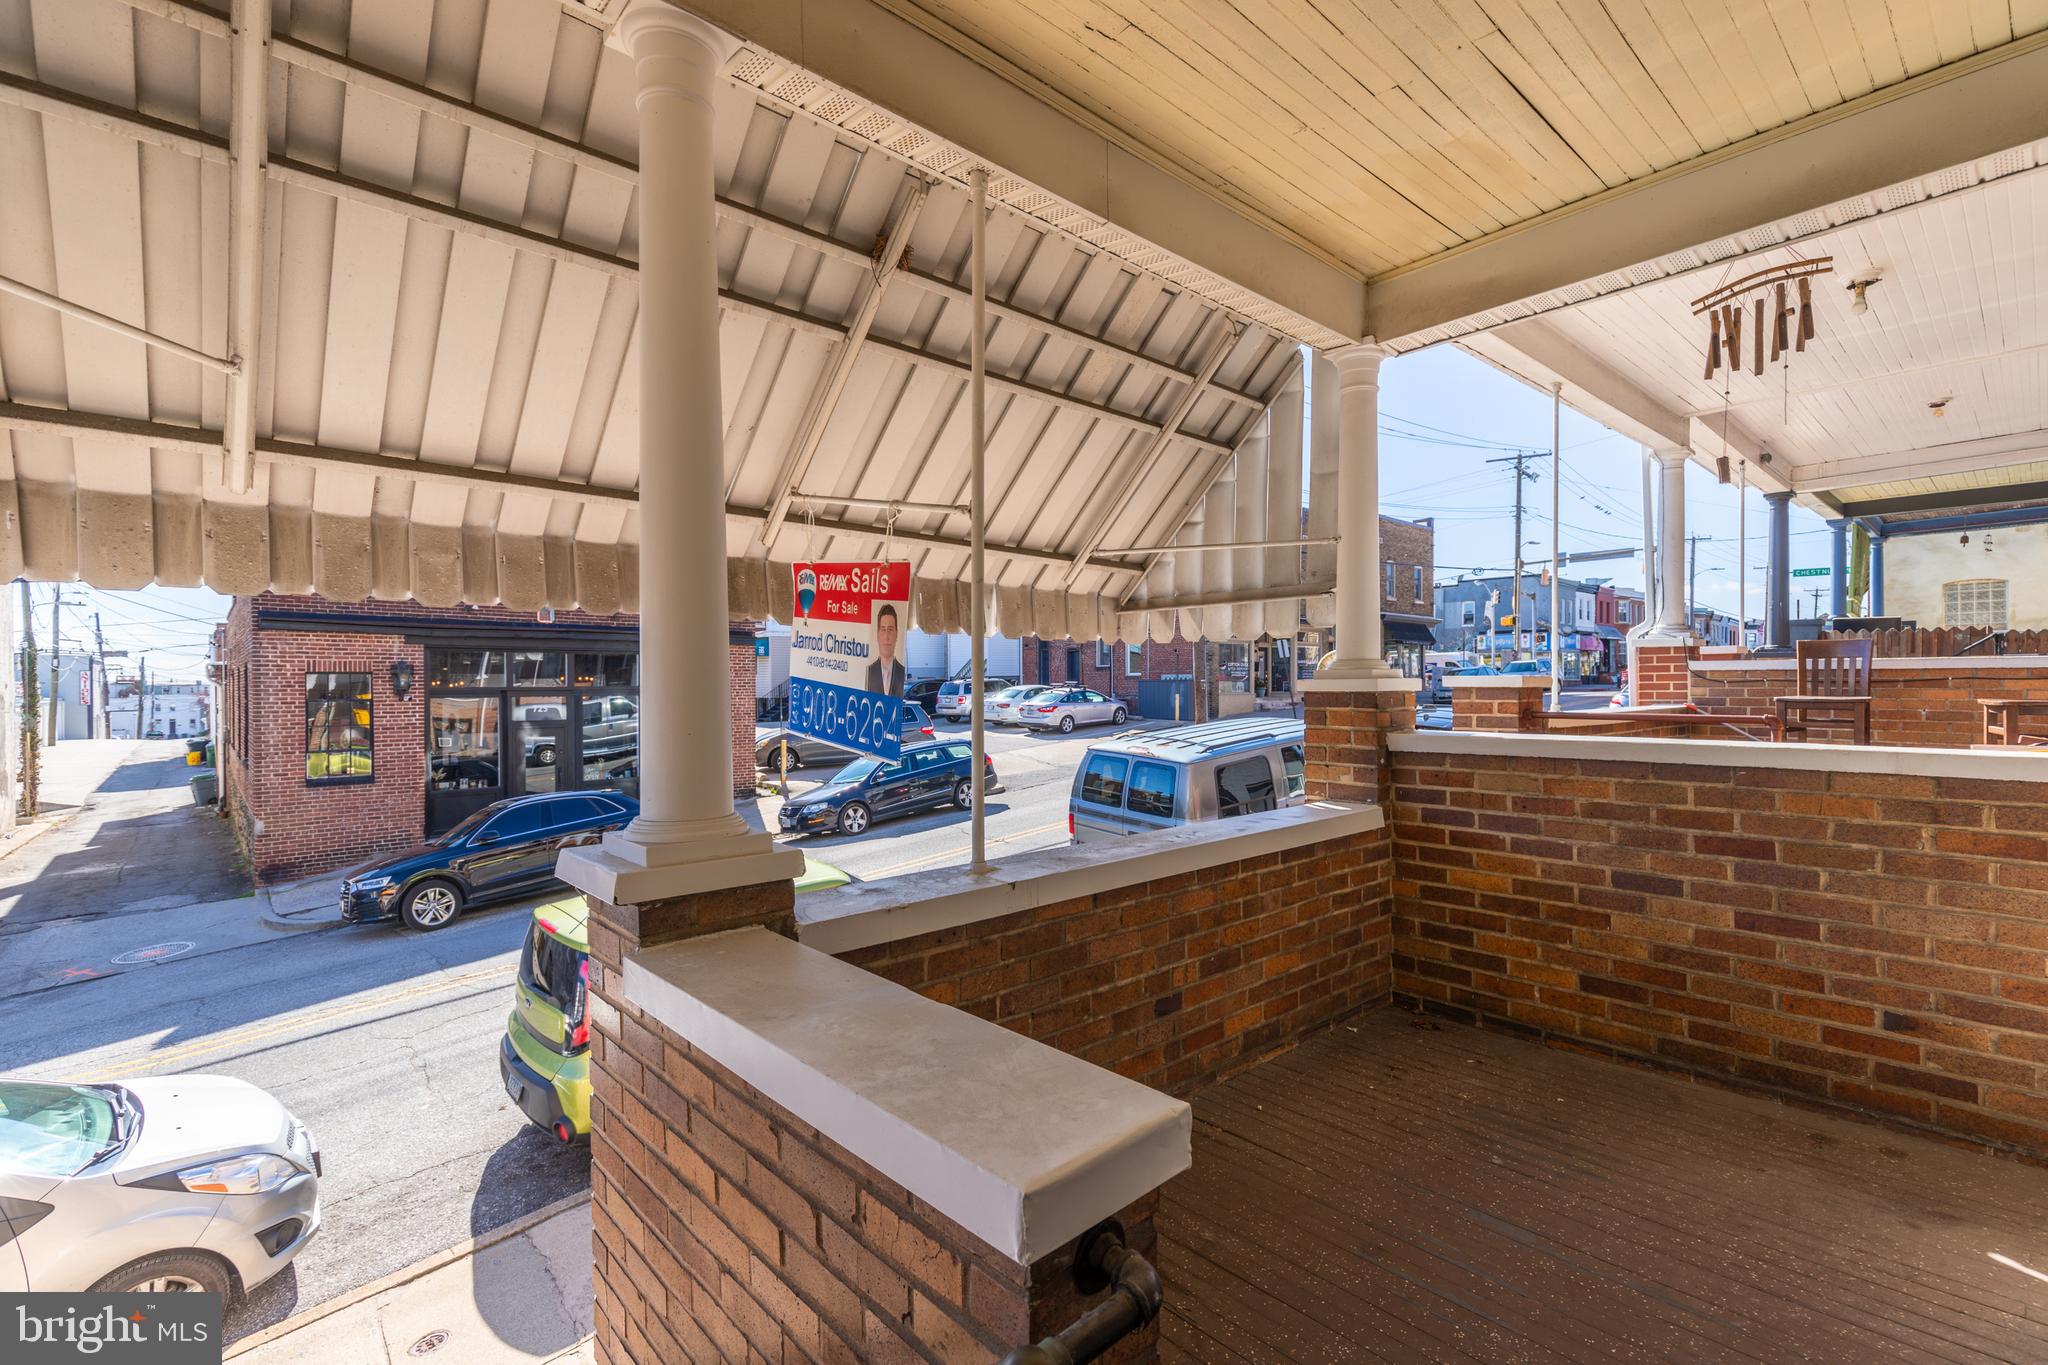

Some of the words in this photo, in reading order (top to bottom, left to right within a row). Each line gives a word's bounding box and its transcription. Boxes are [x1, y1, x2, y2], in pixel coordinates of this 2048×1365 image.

[850, 567, 889, 594] Sails
[826, 599, 840, 614] For
[841, 600, 859, 615] Sale
[792, 631, 823, 651] Jarrod
[825, 633, 869, 658] Christou
[802, 684, 900, 750] 908-6264
